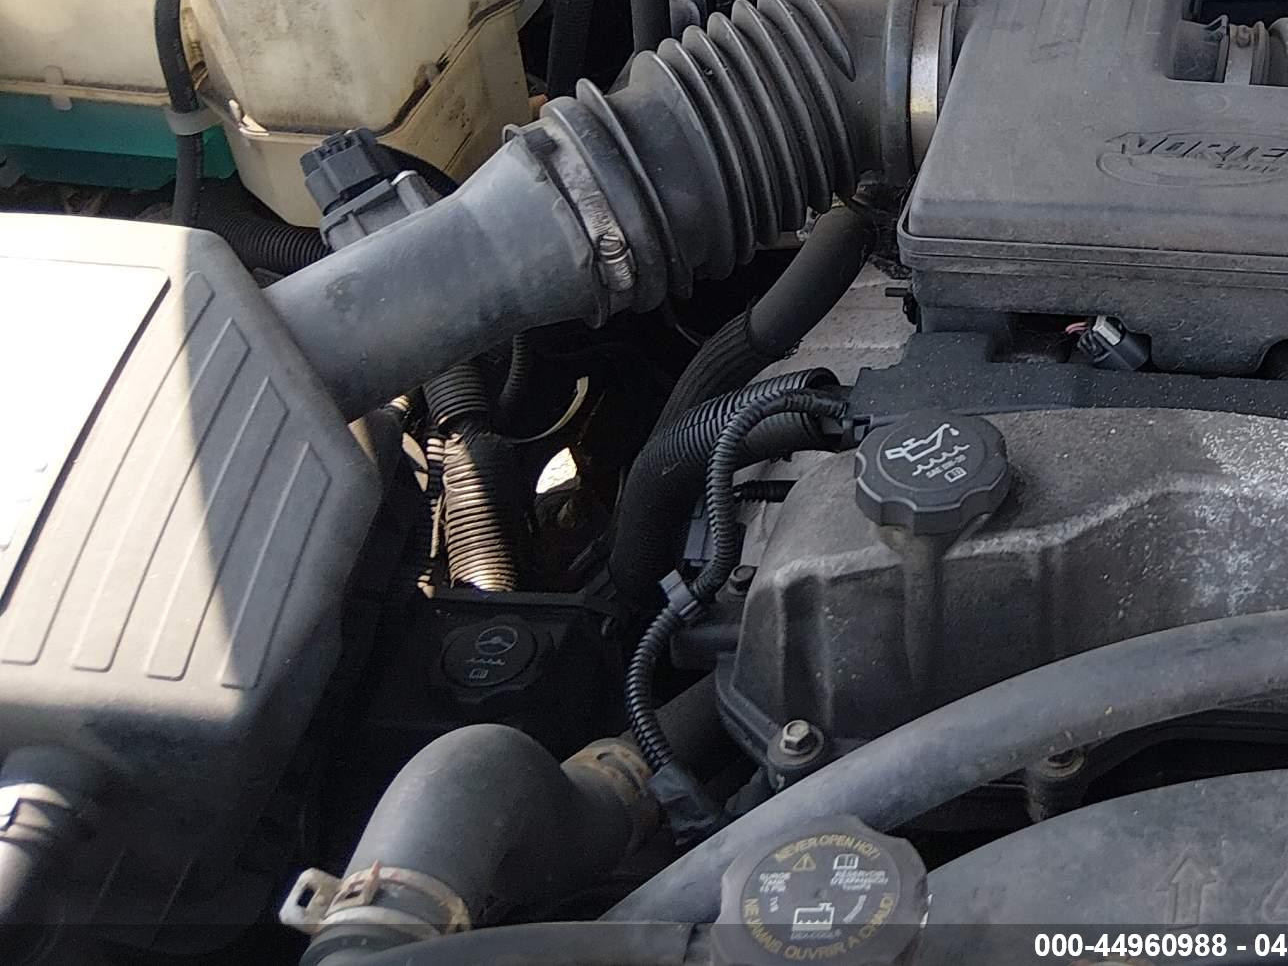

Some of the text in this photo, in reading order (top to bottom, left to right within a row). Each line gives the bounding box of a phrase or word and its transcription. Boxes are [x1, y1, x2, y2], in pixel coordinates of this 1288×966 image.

[774, 837, 817, 862] NEVER
[818, 834, 854, 848] OPEN
[743, 898, 760, 916] NE
[746, 918, 784, 955] JAMAIS
[783, 942, 846, 961] OUVRIR
